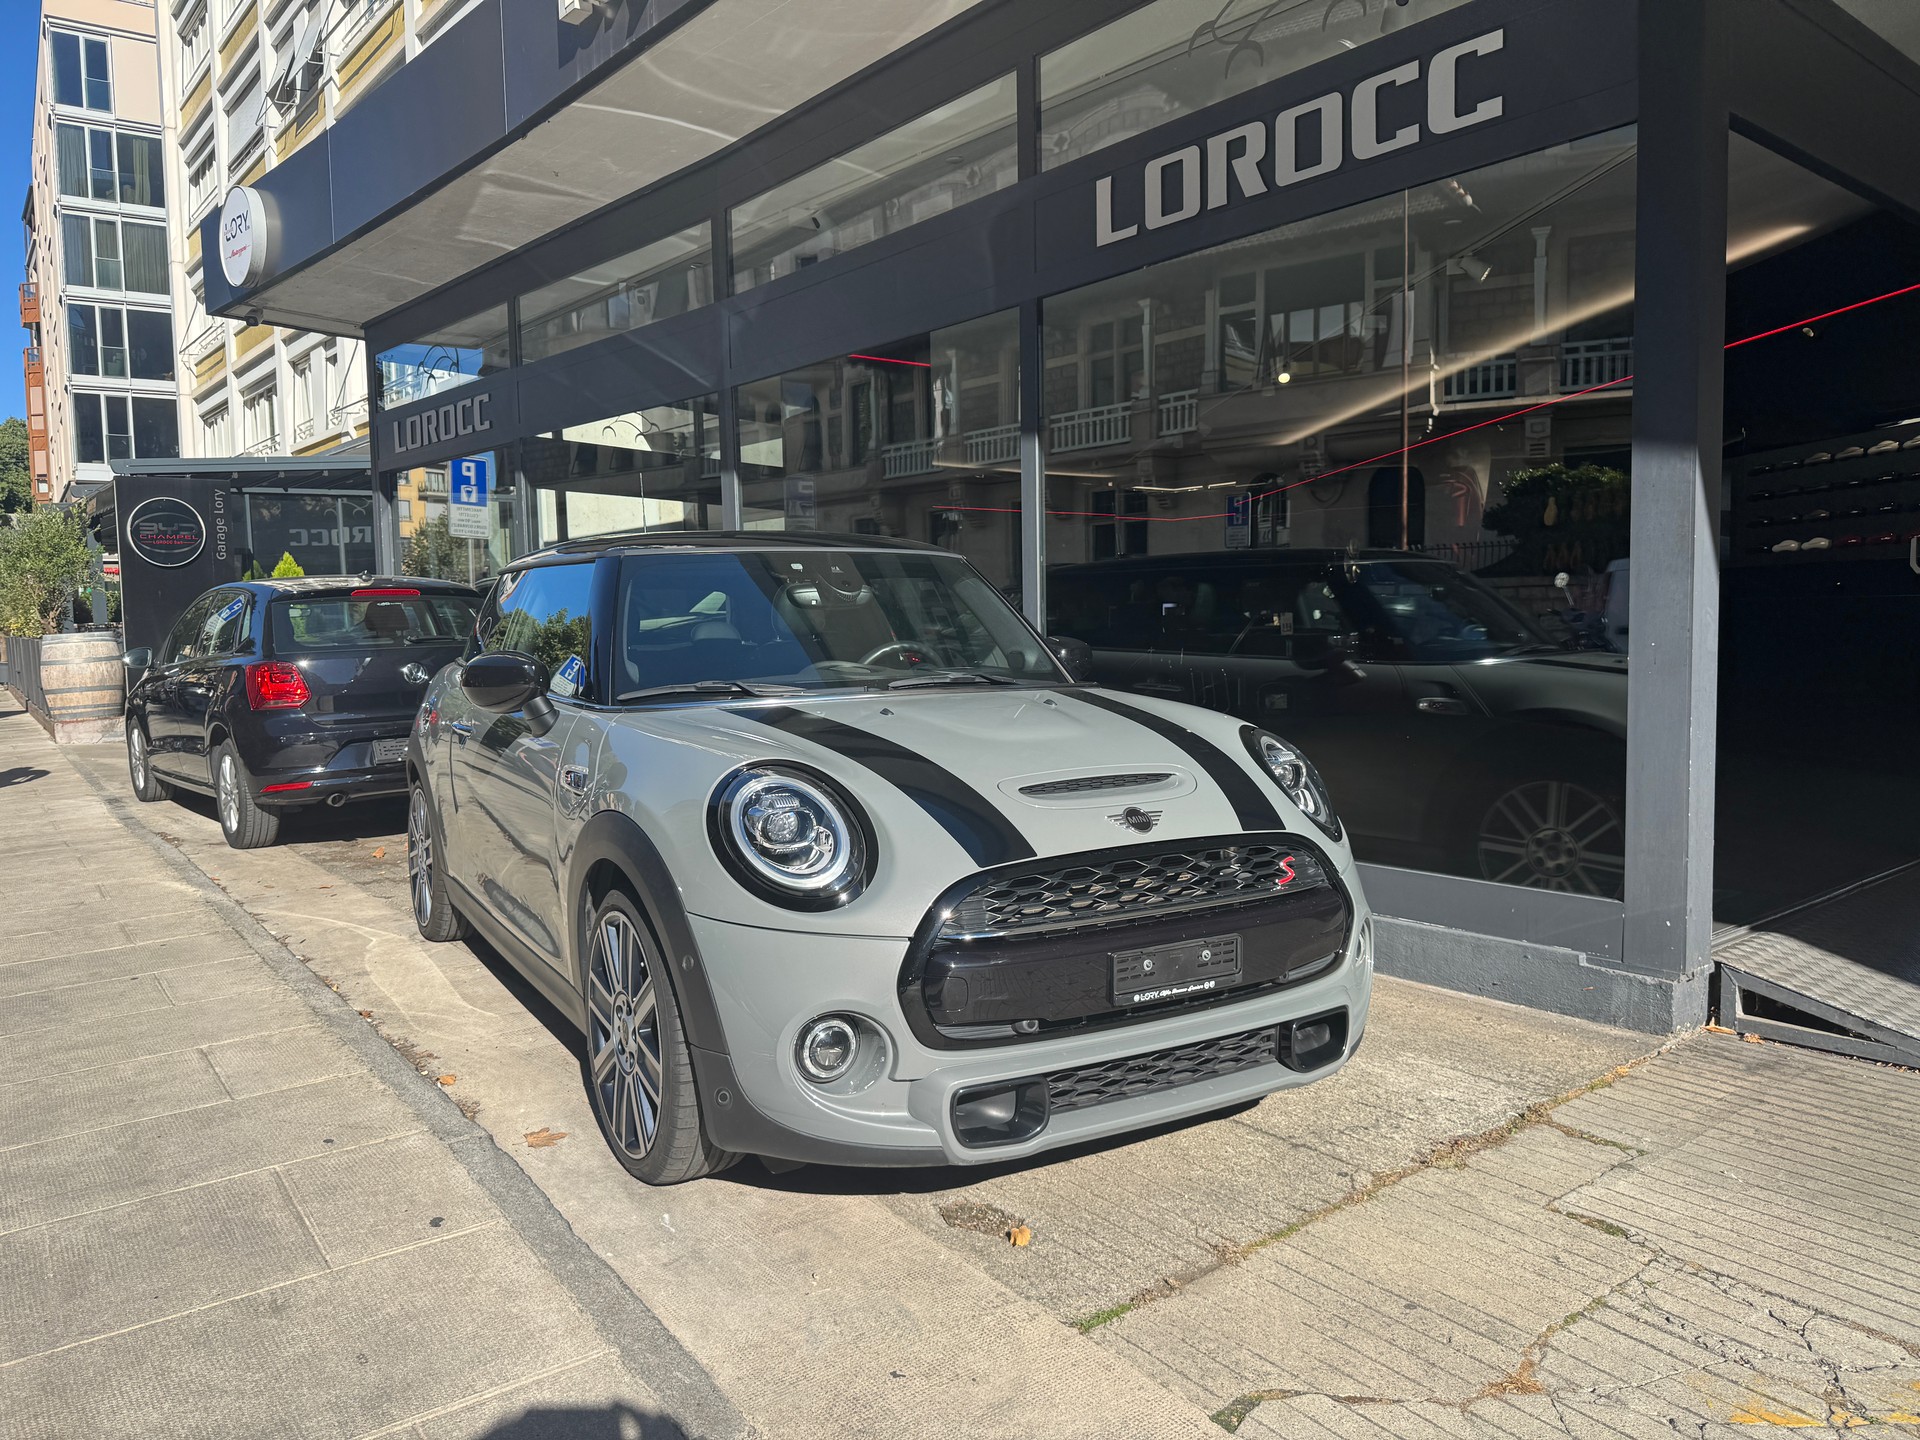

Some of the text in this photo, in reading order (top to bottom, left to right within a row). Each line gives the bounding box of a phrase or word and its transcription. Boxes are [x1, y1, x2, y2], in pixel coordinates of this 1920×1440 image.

[1096, 28, 1504, 248] LOROCC
[393, 393, 490, 453] LOROCC
[214, 489, 228, 560] Garage Lory
[1127, 815, 1149, 824] MINI
